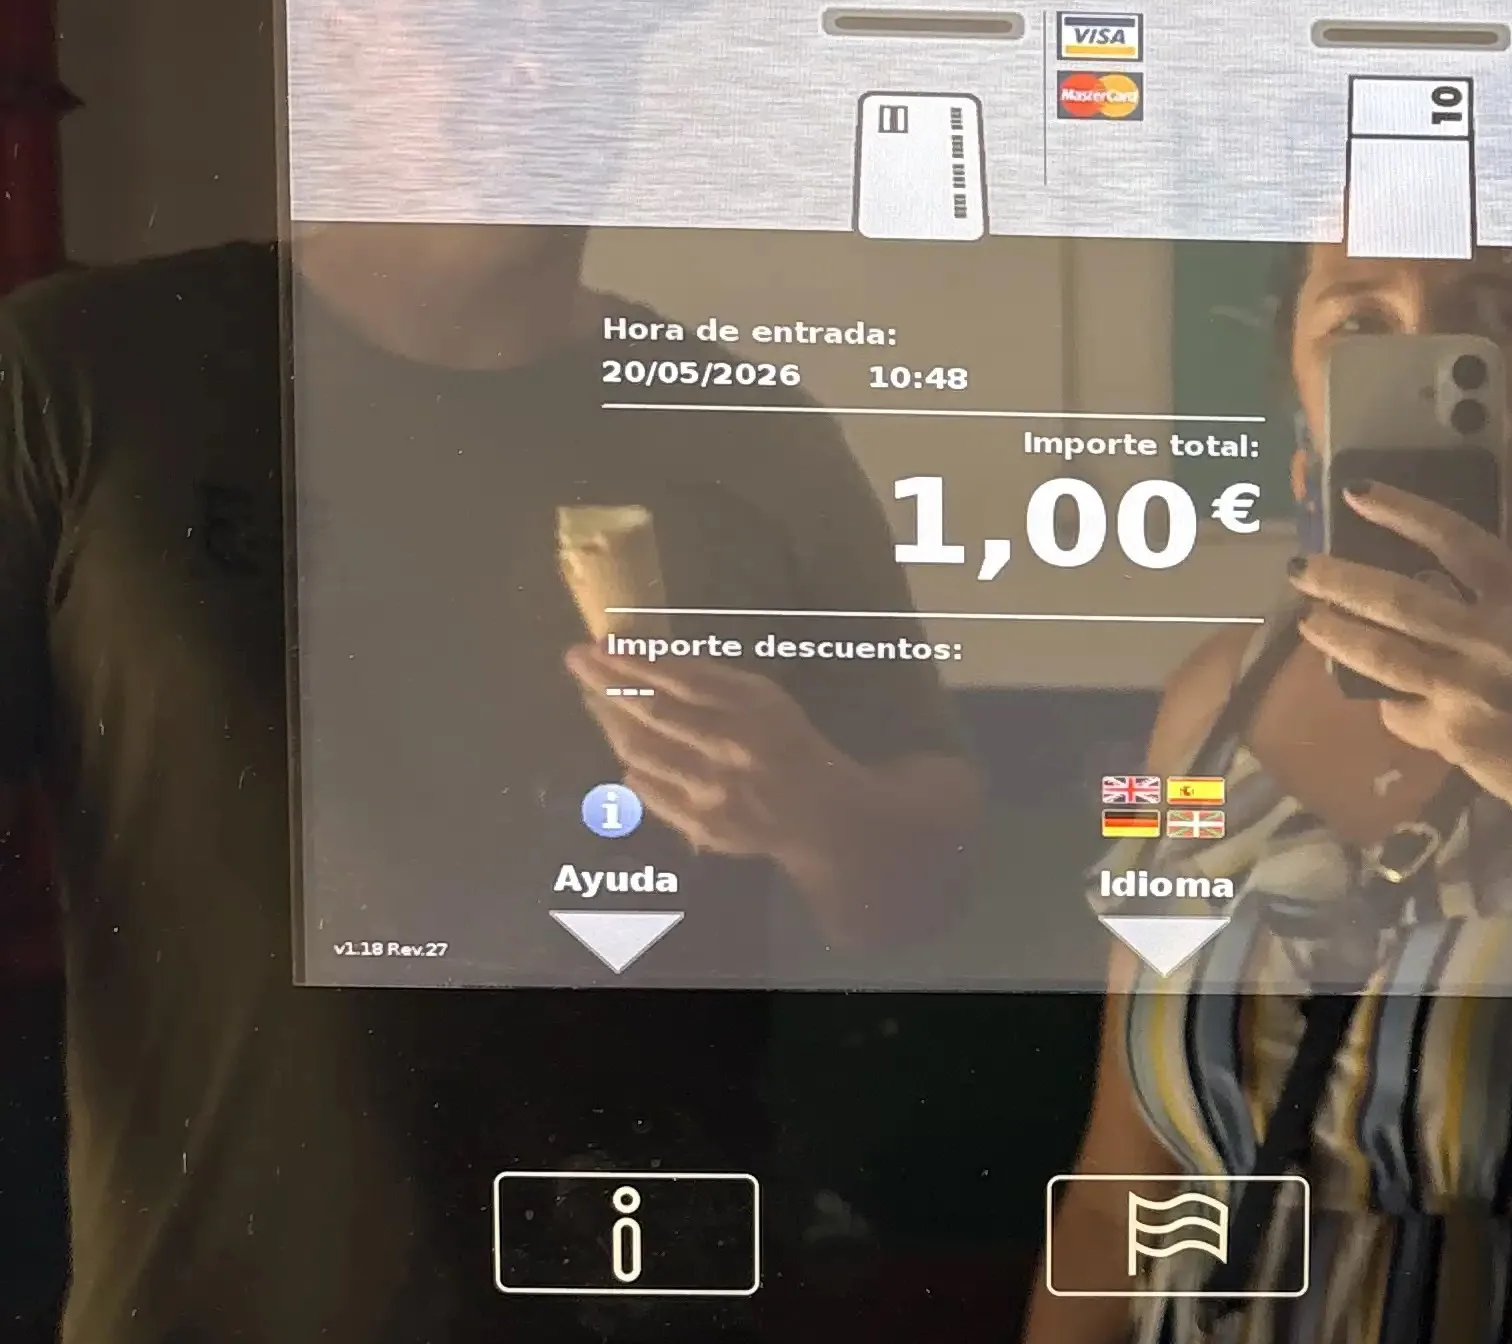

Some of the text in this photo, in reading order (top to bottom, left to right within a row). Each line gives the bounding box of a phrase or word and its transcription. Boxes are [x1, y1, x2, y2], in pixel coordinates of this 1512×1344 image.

[1074, 27, 1126, 45] VISA
[1431, 86, 1463, 125] 10
[603, 317, 898, 348] Hora de entrada:
[601, 360, 969, 392] 20/05/2026 10:48
[1023, 430, 1261, 460] Importe total:
[607, 632, 963, 662] Importe descuentos:
[554, 865, 679, 899] Ayuda
[1100, 869, 1235, 900] Idioma
[333, 941, 448, 957] v1.18 Rev.27
